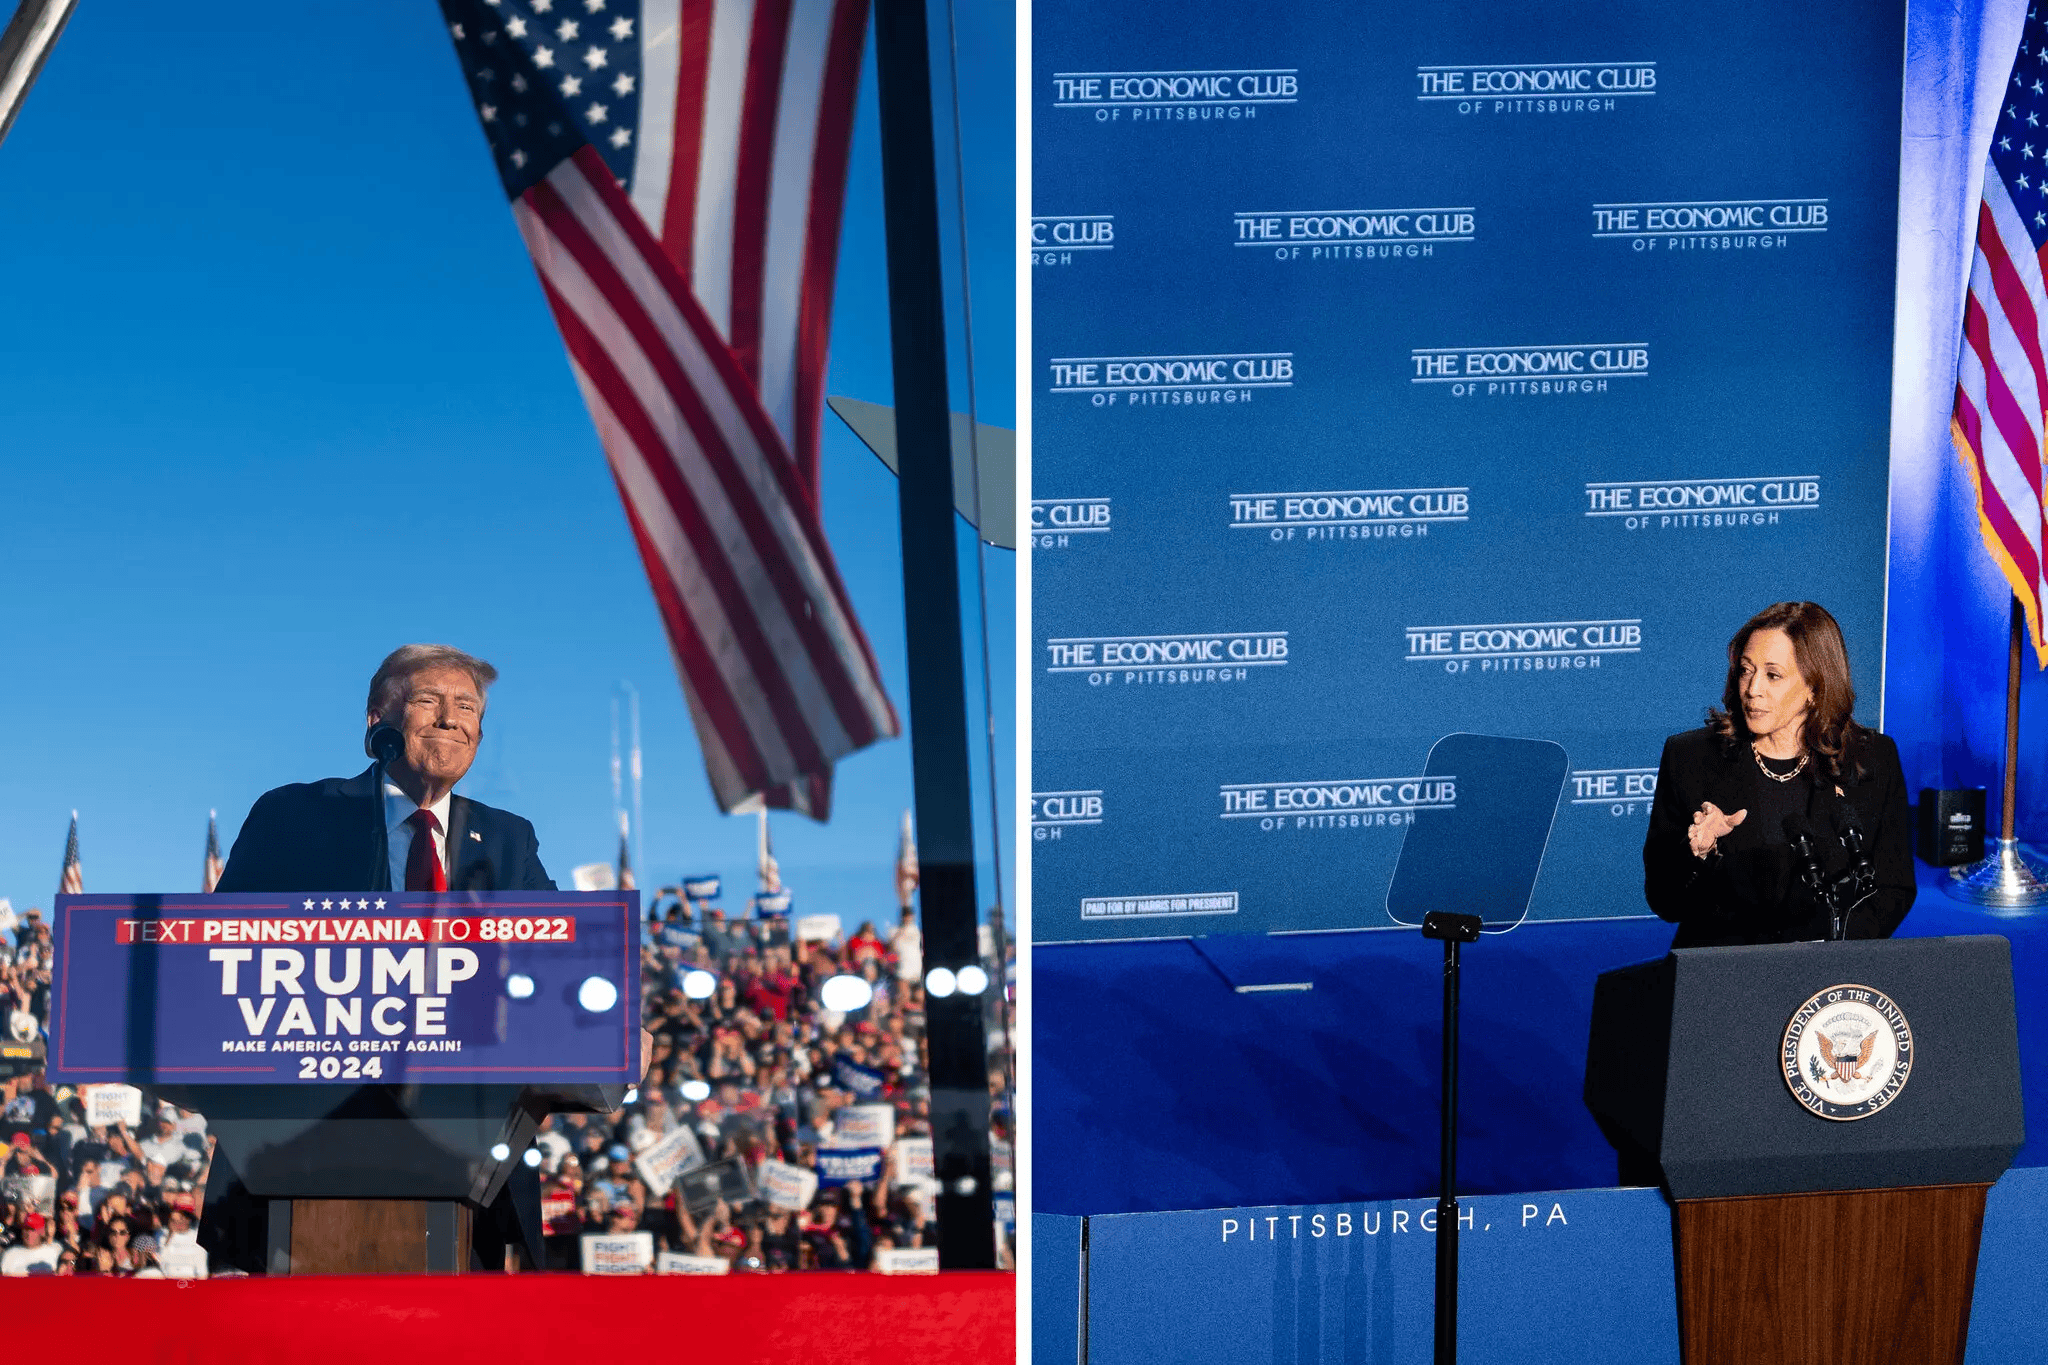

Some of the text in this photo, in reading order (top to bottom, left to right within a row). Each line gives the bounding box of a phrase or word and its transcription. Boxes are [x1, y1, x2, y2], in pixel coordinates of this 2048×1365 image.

[1053, 71, 1298, 100] THE ECONOMIC CLUB
[1417, 65, 1656, 93] THE ECONOMIC CLUB
[1095, 104, 1257, 122] OF PITTSBURGH
[1458, 98, 1616, 114] OF PITTSBURGH
[1234, 211, 1475, 240] THE ECONOMIC CLUB
[1593, 202, 1828, 231] THE ECONOMIC CLUB
[1053, 219, 1113, 244] CLUB
[1632, 234, 1788, 251] OF PITTSBURGH
[1275, 244, 1434, 260] OF PITTSBURGH
[1050, 356, 1293, 385] THE ECONOMIC CLUB
[1412, 345, 1648, 376] THE ECONOMIC CLUB
[1092, 388, 1252, 405] OF PITTSBURGH
[1451, 379, 1608, 397] OF PITTSBURGH
[1230, 491, 1468, 521] THE ECONOMIC CLUB
[1586, 478, 1819, 510] THE ECONOMIC CLUB
[1050, 499, 1110, 525] CLUB
[1626, 511, 1779, 530] OF PITTSBURGH
[1271, 524, 1428, 541] OF PITTSBURGH
[1406, 622, 1641, 653] THE ECONOMIC CLUB
[1047, 636, 1288, 667] THE ECONOMIC CLUB
[1088, 668, 1247, 686] OF PITTSBURGH
[1444, 655, 1601, 674] OF PITTSBURGH
[1221, 777, 1456, 812] THE ECONOMIC CLUB
[1572, 772, 1617, 797] THE
[1041, 794, 1102, 819] CLUB
[1611, 803, 1635, 816] OF
[1261, 812, 1415, 831] OF PITTSBURGH
[123, 918, 568, 942] TEXT PENNSYLVANIA TO 88022
[209, 947, 479, 995] TRUMP
[237, 996, 447, 1036] VANCE
[222, 1041, 461, 1052] MAKE AMERICA GREAT AGAIN!
[1786, 989, 1910, 1113] VICE PRESIDENT OF THE UNITED STATES
[299, 1056, 383, 1079] 2024
[1523, 1202, 1568, 1227] PA
